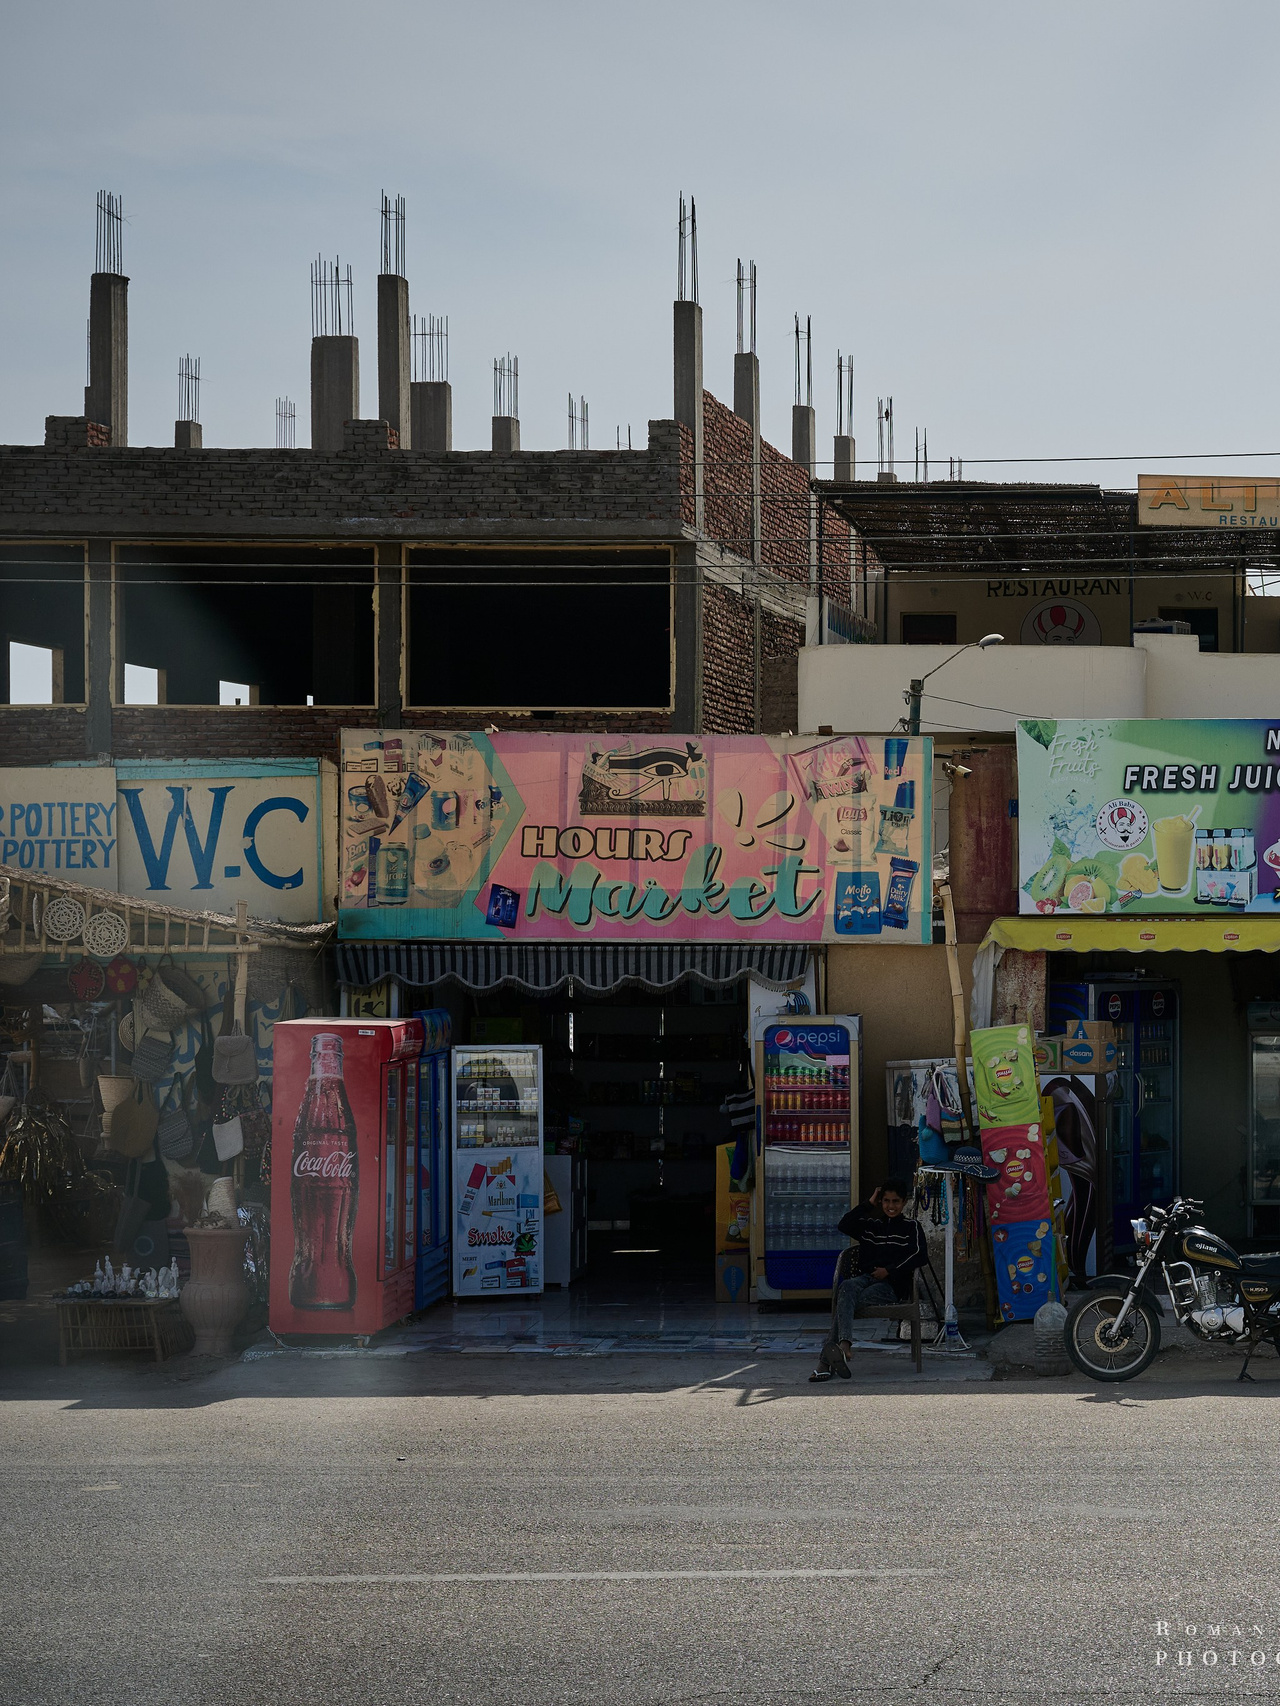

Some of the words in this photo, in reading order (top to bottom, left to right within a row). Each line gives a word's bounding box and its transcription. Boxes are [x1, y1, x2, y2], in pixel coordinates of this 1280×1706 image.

[1148, 481, 1257, 512] ALI
[1050, 732, 1099, 756] Fresh
[884, 766, 900, 776] Red
[1048, 752, 1101, 778] Fruits
[1123, 764, 1219, 790] FRESH
[1108, 802, 1118, 811] Ali
[1118, 801, 1136, 809] Baba
[10, 802, 117, 838] POTTERY
[840, 828, 863, 836] Classic
[2, 838, 117, 869] POTTERY
[521, 826, 693, 862] HOURS
[525, 843, 822, 930] Market
[845, 884, 872, 898] Molto
[890, 886, 909, 898] Dairy
[796, 1029, 841, 1046] pepsi
[1069, 1049, 1093, 1057] dasani
[293, 1150, 357, 1178] Coca-Cola
[488, 1191, 515, 1207] Marlboro
[467, 1225, 515, 1247] Smoke
